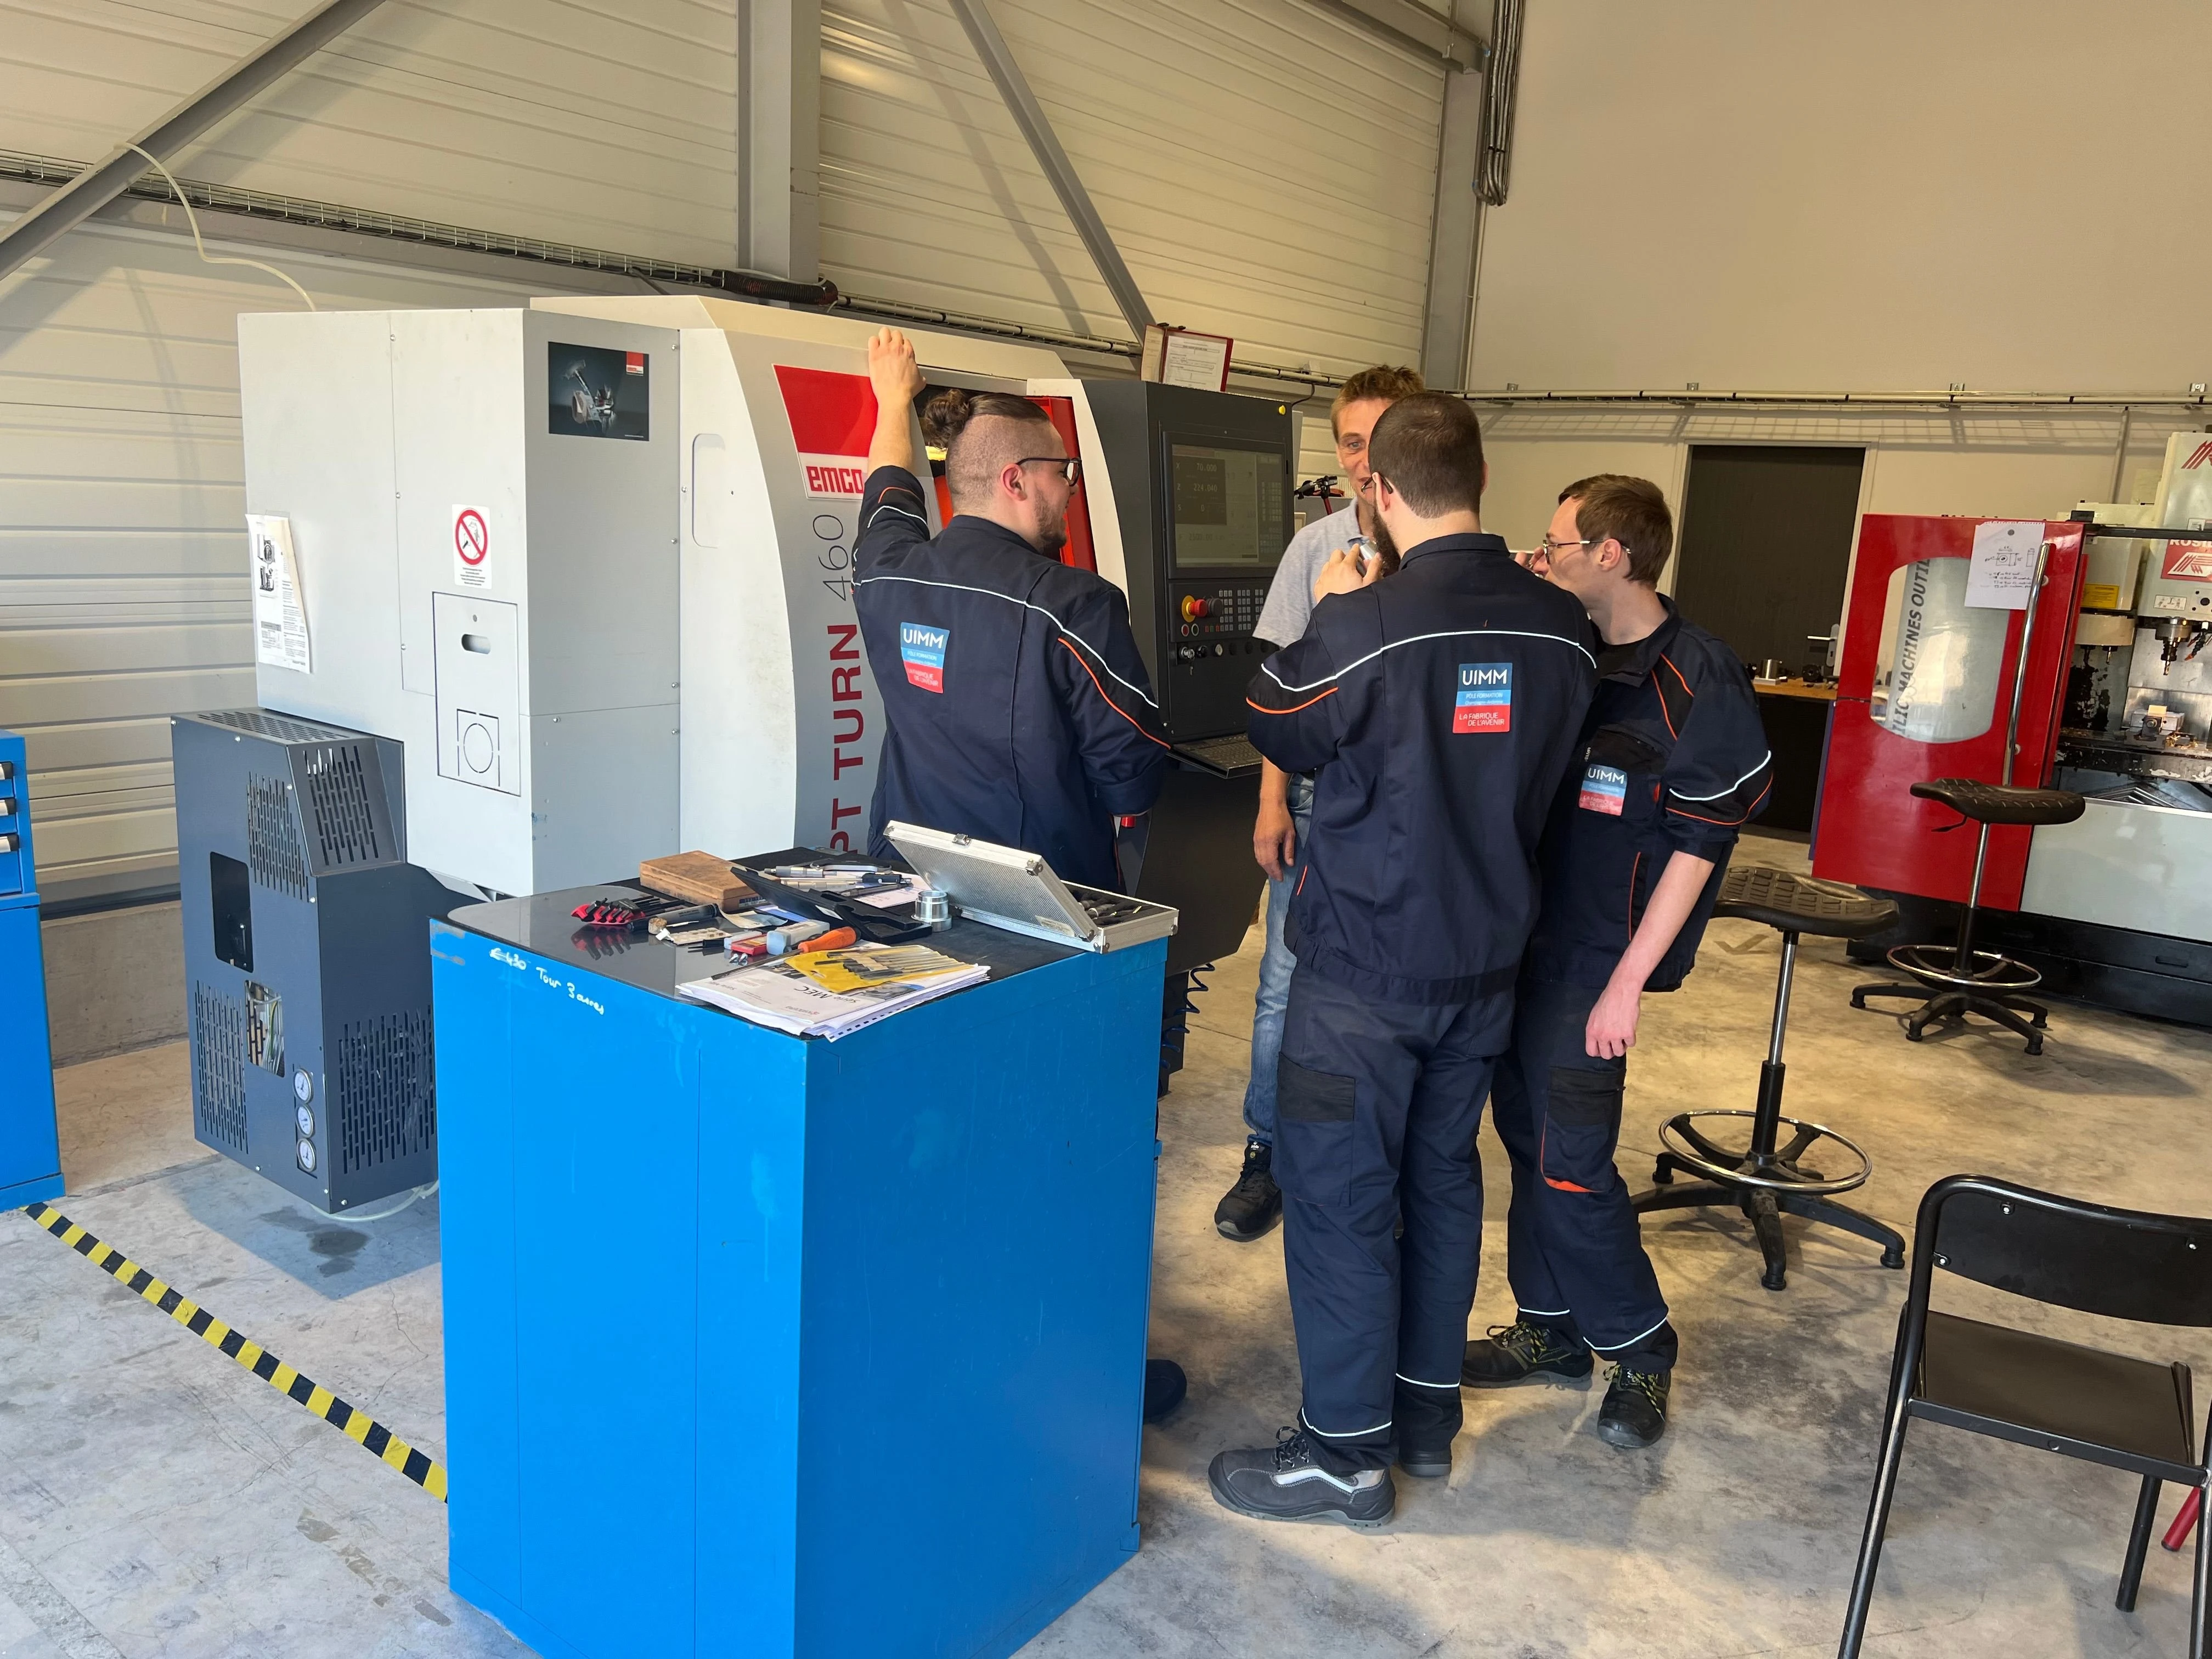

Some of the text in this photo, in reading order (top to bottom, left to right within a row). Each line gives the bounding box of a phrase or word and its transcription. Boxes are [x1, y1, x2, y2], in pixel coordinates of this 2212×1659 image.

[806, 466, 864, 494] emco
[812, 515, 851, 601] 460
[903, 628, 944, 649] UIMM
[1898, 610, 1922, 693] MACHINES
[1462, 669, 1508, 686] UIMM
[827, 624, 864, 781] TURN
[1588, 767, 1624, 785] UIMM
[536, 967, 562, 988] Tour
[794, 986, 832, 999] MEC
